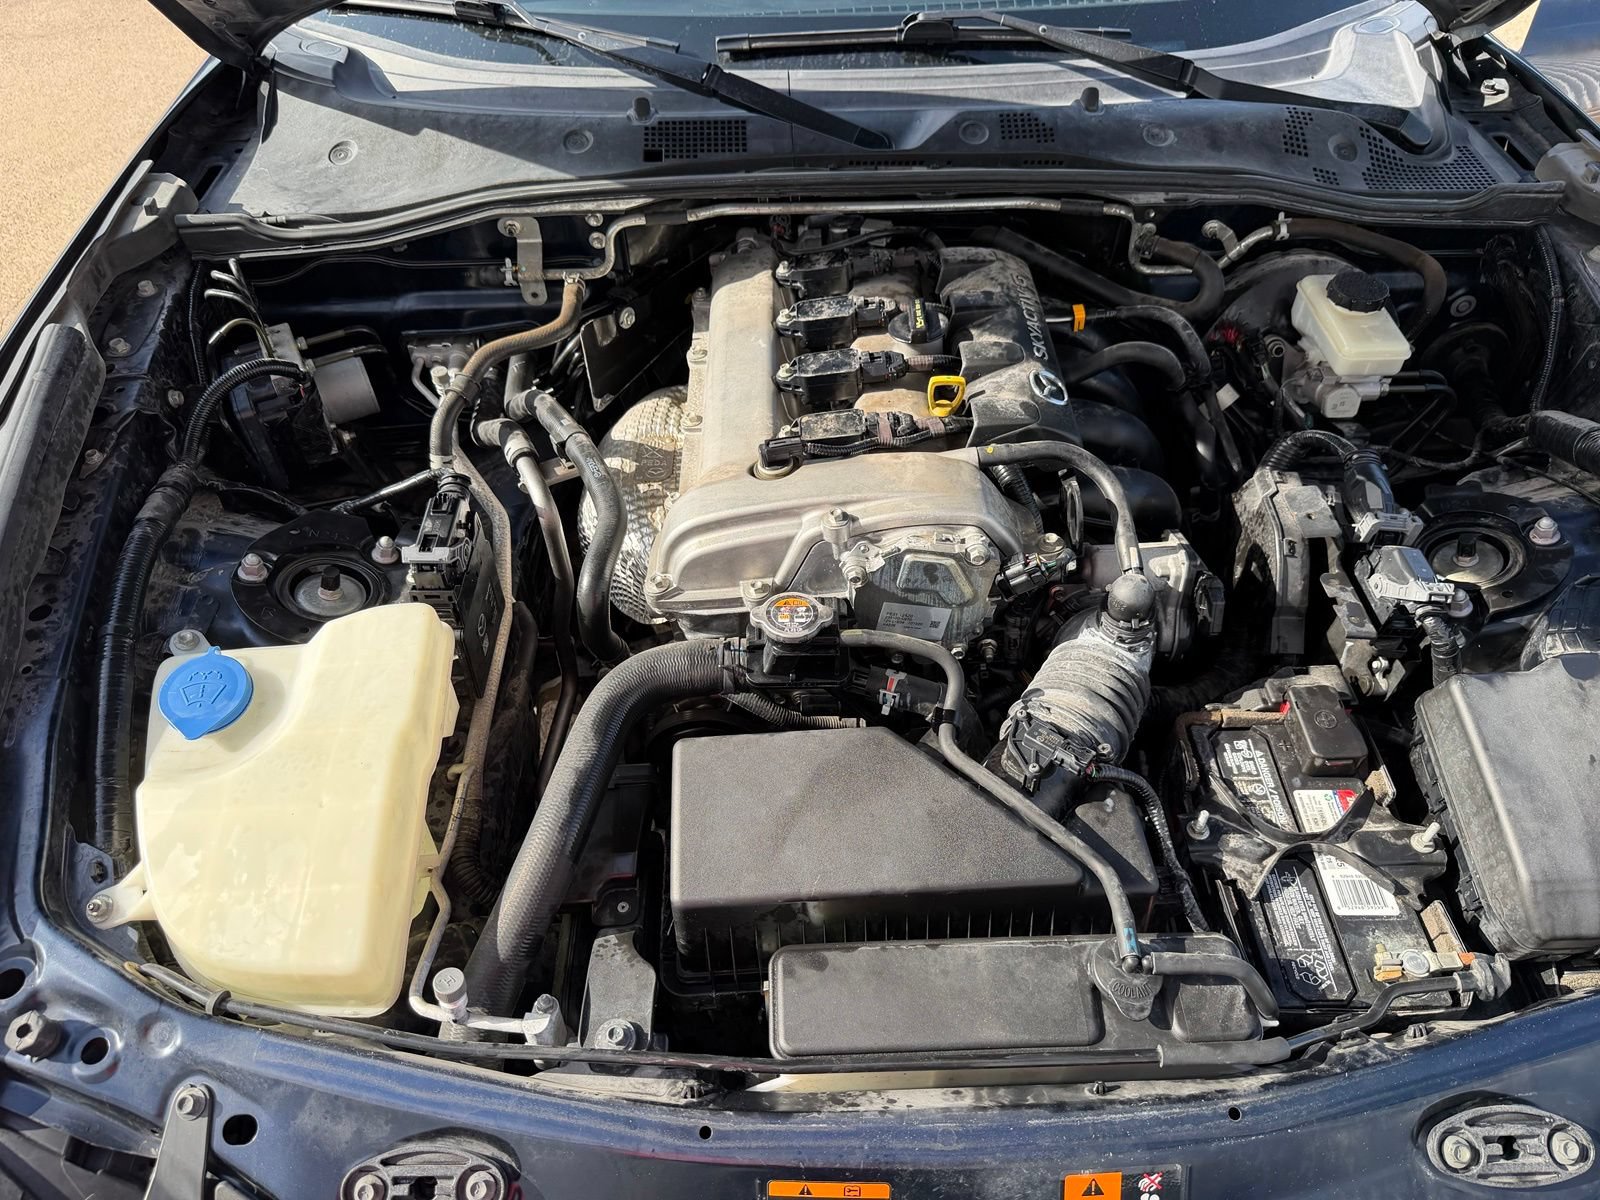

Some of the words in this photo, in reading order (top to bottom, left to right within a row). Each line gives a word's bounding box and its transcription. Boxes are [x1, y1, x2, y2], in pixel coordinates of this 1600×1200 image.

[1258, 757, 1274, 788] DANGER
[1270, 794, 1288, 824] POISON
[1112, 982, 1154, 998] COOLANT
